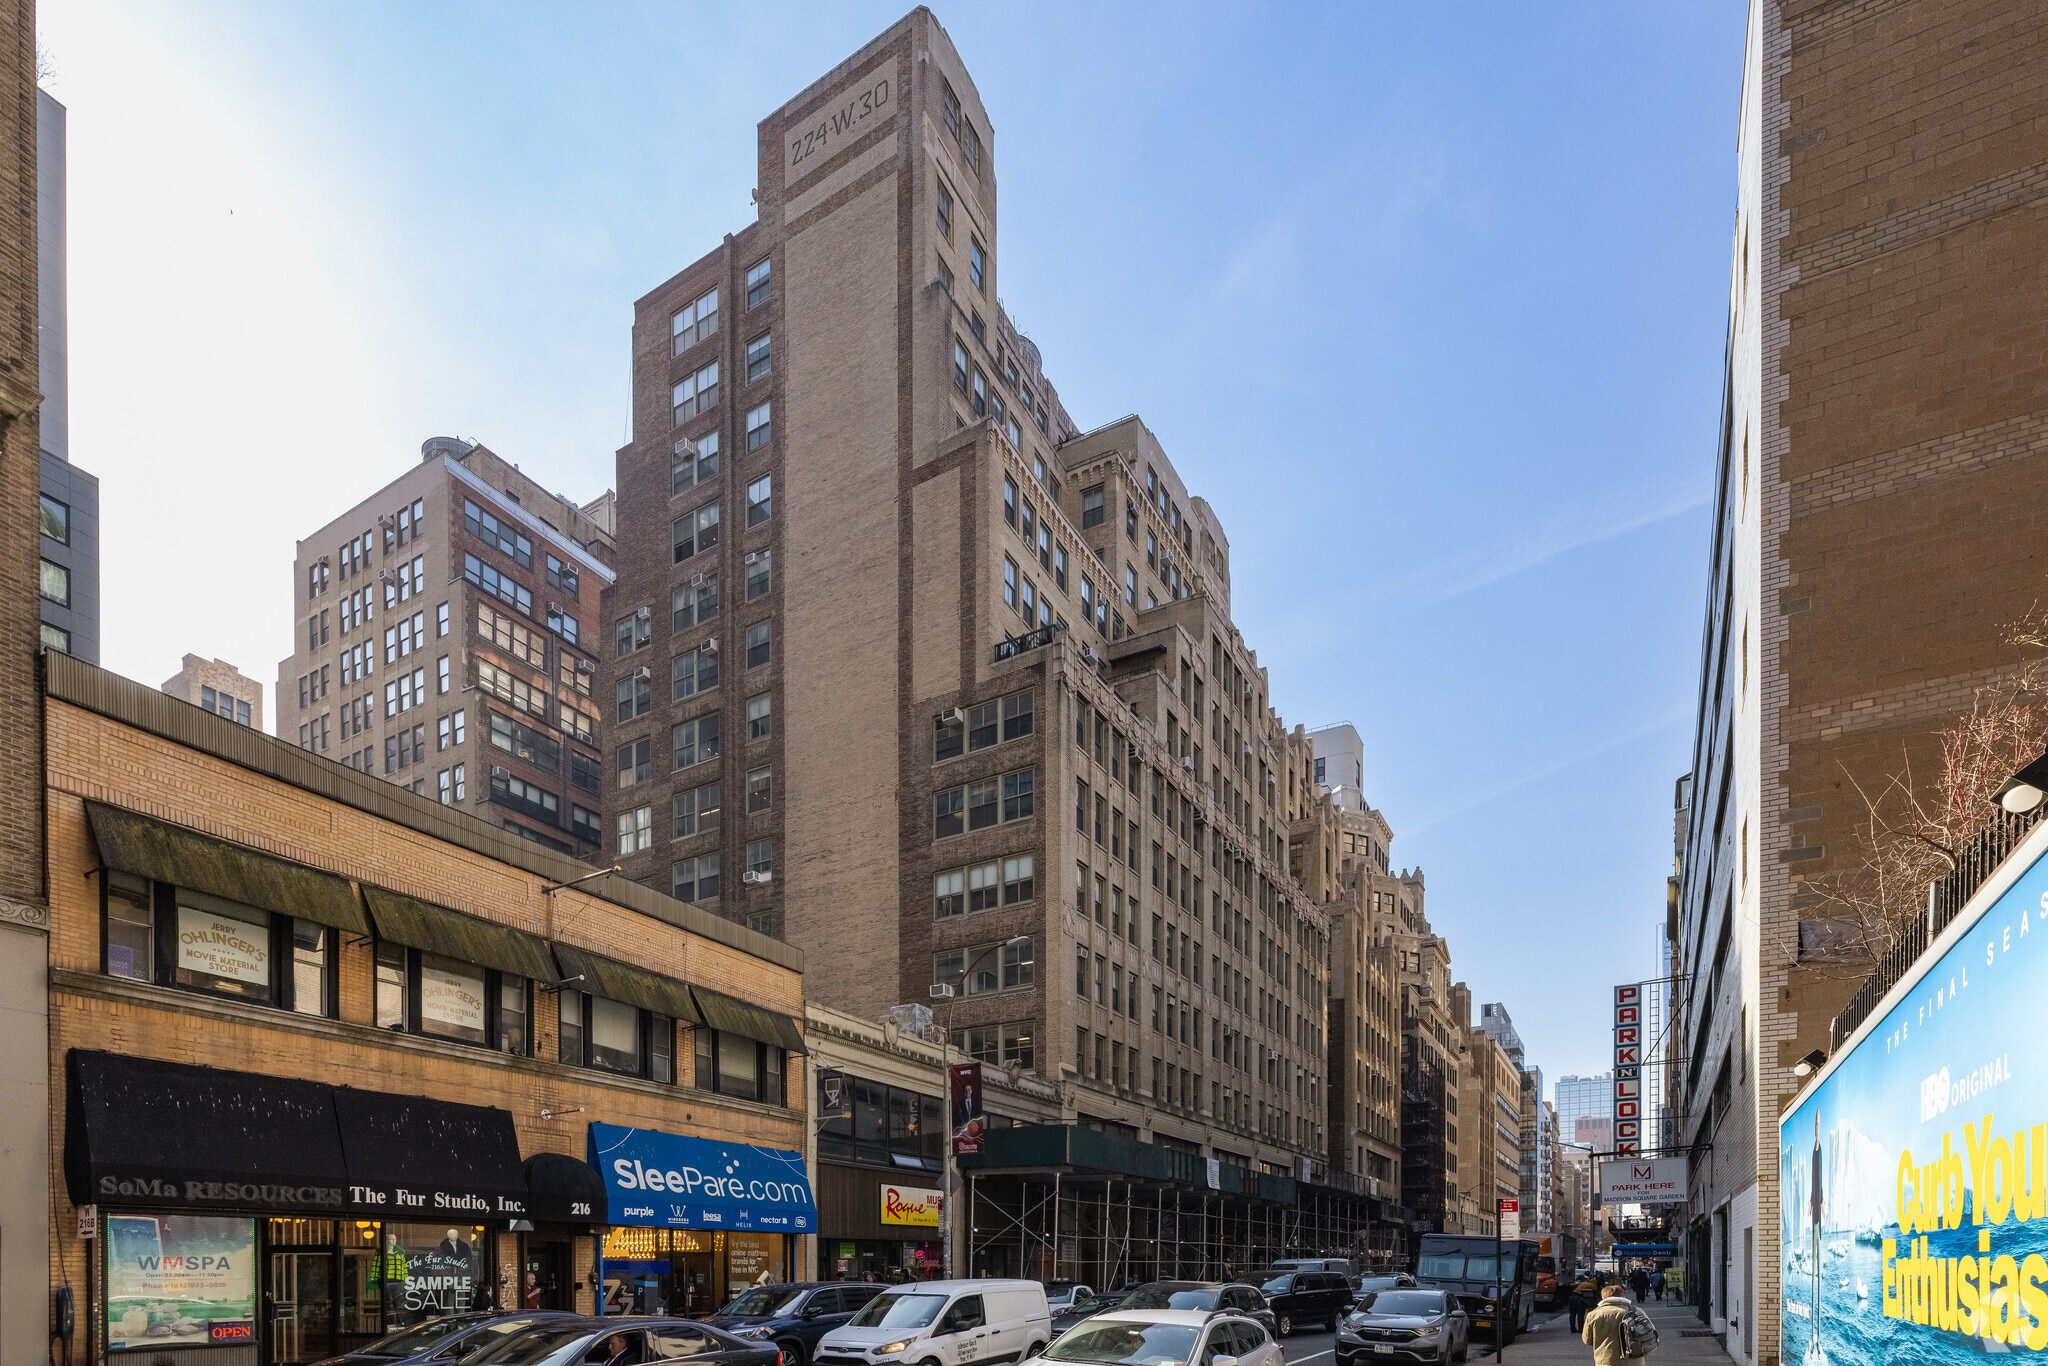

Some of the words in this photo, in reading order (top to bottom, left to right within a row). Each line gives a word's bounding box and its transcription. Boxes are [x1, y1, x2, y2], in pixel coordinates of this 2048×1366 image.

[211, 922, 236, 935] JERRY
[180, 930, 267, 962] OHLINGER'S
[186, 948, 217, 962] MOVIE
[219, 956, 260, 972] MATERIAL
[209, 962, 239, 975] STORE
[423, 986, 483, 1011] OHLINGER'S
[426, 1001, 447, 1011] MOVIE
[450, 1007, 478, 1019] MATERIAL
[442, 1011, 463, 1022] STORE
[1887, 1021, 1908, 1054] THE
[1919, 967, 1968, 1026] FINAL
[1618, 987, 1637, 1063] PARK
[1920, 1066, 1950, 1124] HBO
[1951, 1053, 2011, 1107] ORIGINAL
[1618, 1082, 1637, 1157] LOCK
[100, 1176, 178, 1197] SoMa
[184, 1180, 343, 1205] RESOURCES
[613, 1158, 808, 1204] SleePare.com
[1612, 1184, 1641, 1192] PARK
[1645, 1182, 1675, 1190] HERE
[1896, 1131, 1964, 1235] Curb
[350, 1186, 386, 1204] The
[396, 1188, 426, 1207] Fur
[434, 1191, 490, 1214] Studio,
[497, 1195, 526, 1213] Inc.
[571, 1202, 591, 1216] 216
[624, 1206, 655, 1218] purple
[703, 1209, 722, 1222] leesa
[79, 1217, 95, 1229] 216B
[406, 1255, 422, 1269] The
[425, 1252, 442, 1264] Fur
[444, 1256, 468, 1269] Studio
[404, 1276, 471, 1290] SAMPLE
[404, 1290, 471, 1310] SALE
[212, 1325, 251, 1339] OPEN
